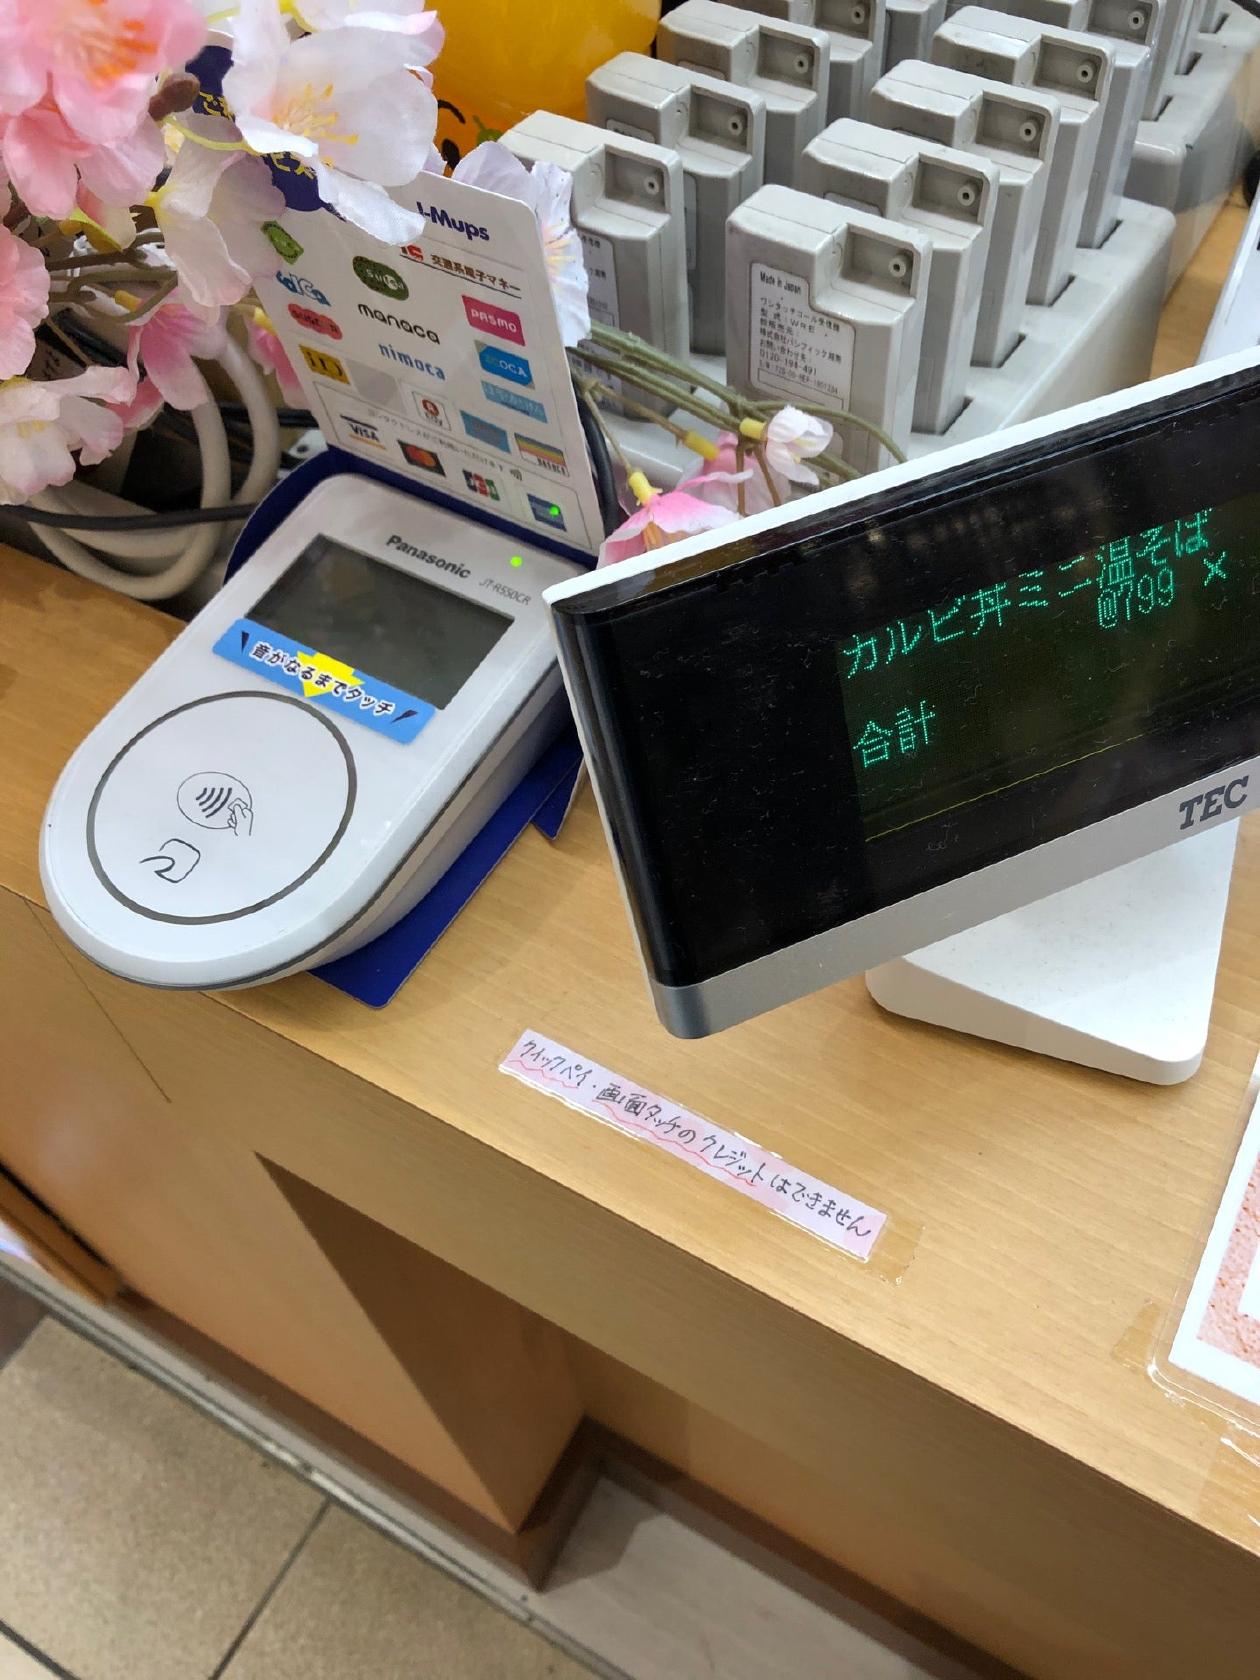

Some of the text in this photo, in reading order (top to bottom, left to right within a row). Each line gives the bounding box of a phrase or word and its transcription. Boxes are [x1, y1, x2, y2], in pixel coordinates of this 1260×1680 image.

[760, 270, 776, 287] Made
[784, 282, 802, 295] Japan
[358, 302, 441, 346] manaca
[471, 308, 518, 334] PASMO
[377, 343, 447, 382] nimoca
[349, 423, 380, 442] VISA
[386, 534, 472, 580] Panasonic
[1096, 567, 1176, 631] @799
[249, 641, 397, 718] 音がなるまでタッチ
[852, 700, 936, 770] 合計
[1178, 774, 1250, 830] TEC
